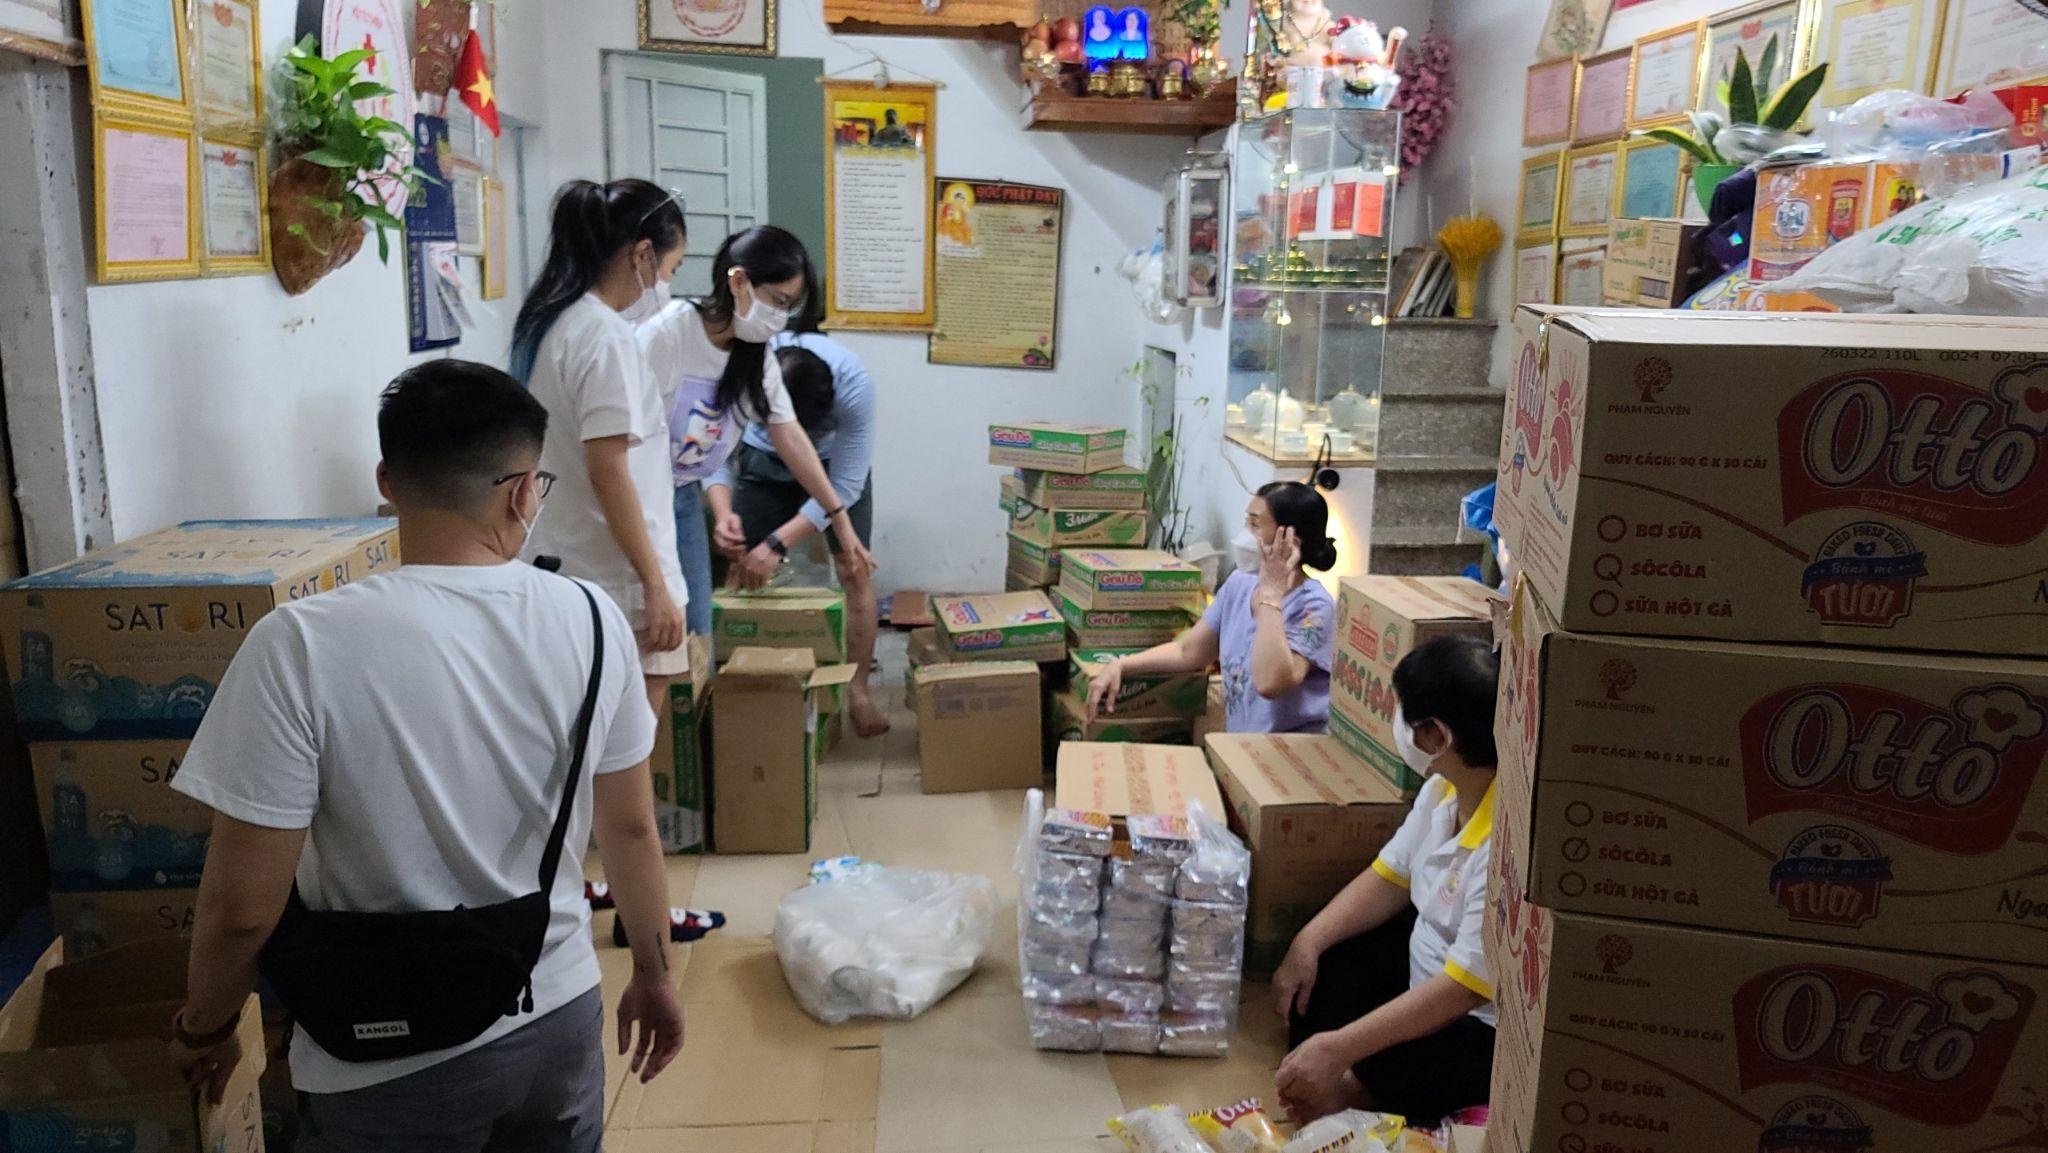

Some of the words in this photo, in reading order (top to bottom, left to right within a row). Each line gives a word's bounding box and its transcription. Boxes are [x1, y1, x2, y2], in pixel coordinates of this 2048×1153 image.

[1801, 377, 2039, 494] Otto
[1604, 453, 1633, 465] QUY
[1635, 522, 1664, 538] BƠ
[1667, 520, 1703, 540] SỮA
[1630, 558, 1706, 579] SÔCÔLA
[1624, 595, 1659, 614] SỮA
[1706, 599, 1733, 618] GÀ
[1571, 743, 1597, 755] QUY
[1763, 689, 2000, 808] Otto
[1602, 810, 1630, 826] BƠ
[1598, 844, 1673, 867] SÔCÔLA
[1569, 1012, 1596, 1026] QUY
[1755, 970, 1978, 1082] Otto
[357, 1024, 407, 1035] KANGOL
